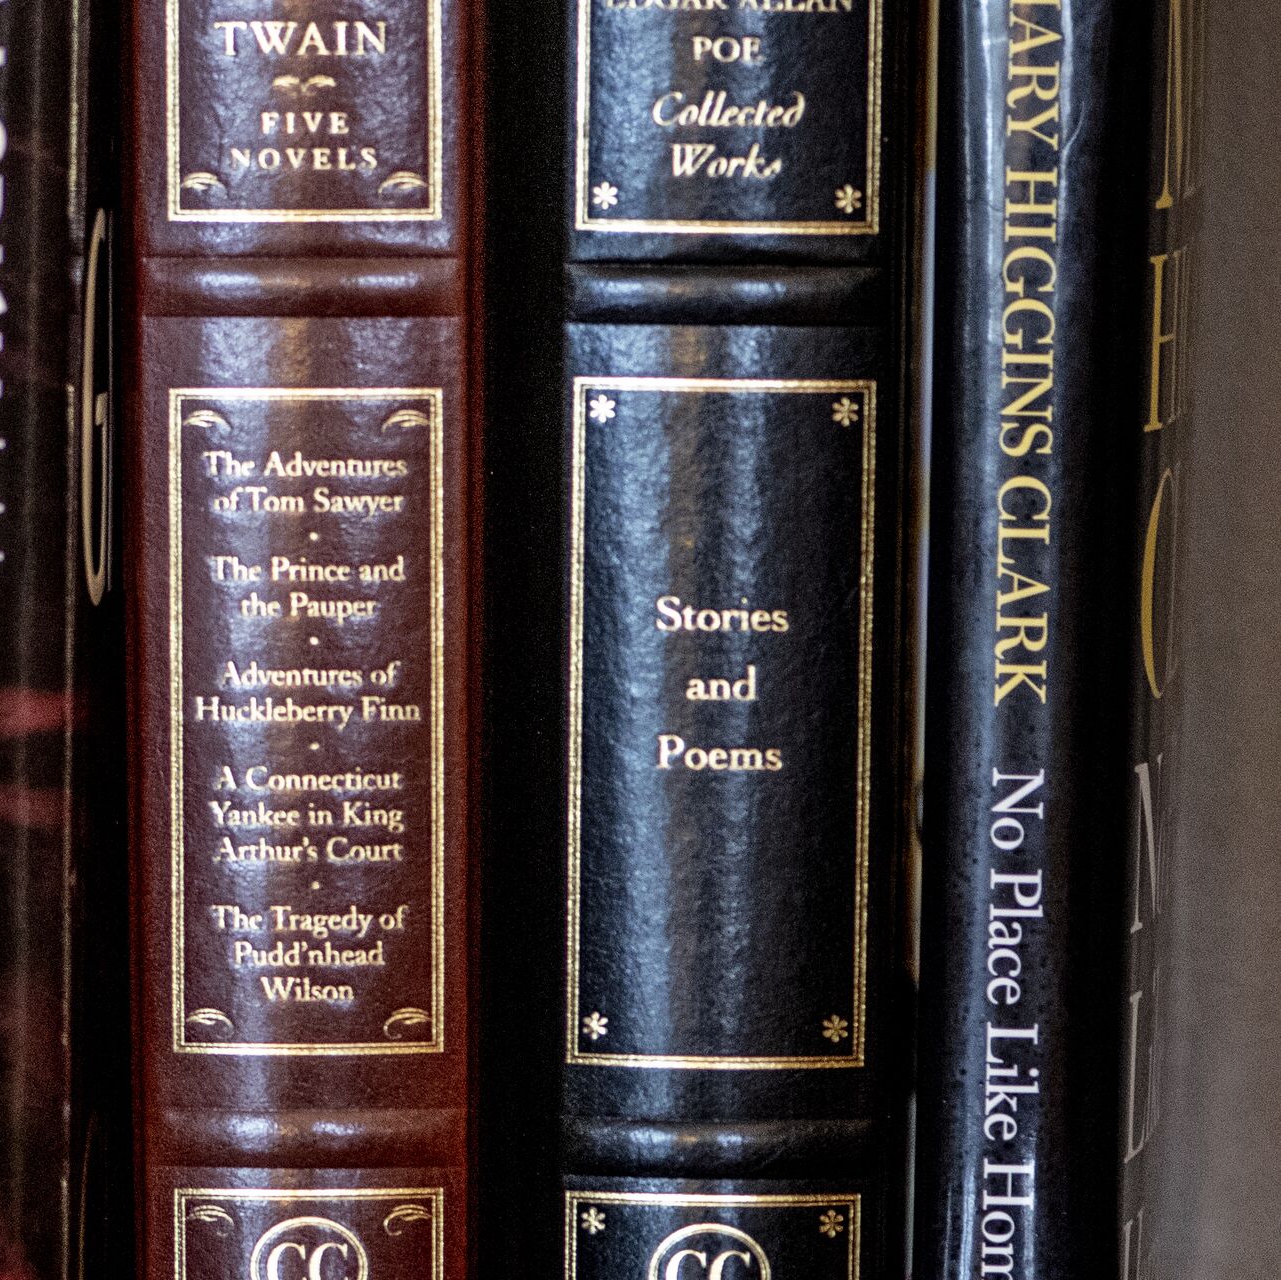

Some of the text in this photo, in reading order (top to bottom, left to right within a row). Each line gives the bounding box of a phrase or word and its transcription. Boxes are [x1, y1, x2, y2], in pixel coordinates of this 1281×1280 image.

[213, 21, 388, 56] TWAIN
[692, 36, 767, 62] POE
[261, 111, 350, 134] FIVE
[652, 90, 806, 127] Collected
[230, 147, 378, 170] NOVELS
[671, 142, 783, 179] Works
[999, 167, 1058, 457] HIGGINS
[203, 451, 408, 477] The Adventures
[213, 486, 404, 516] of Tom Sawyer
[210, 555, 406, 581] The Prince and
[240, 592, 377, 625] the Pauper
[994, 475, 1052, 708] CLARK
[655, 595, 790, 632] Stories
[222, 661, 402, 687] Adventures of
[686, 664, 758, 701] and
[195, 696, 420, 731] Huckleberry Finn
[656, 734, 784, 771] Poems
[215, 765, 403, 791] A Connecticut
[208, 801, 404, 833] Yankee in King
[990, 767, 1045, 851] No
[213, 836, 404, 862] Arthur's Court
[211, 904, 409, 939] The Tragedy of
[986, 869, 1044, 1006] Place
[234, 940, 385, 967] Pudd'nhead
[260, 976, 355, 1002] Wilson
[983, 1021, 1040, 1142] Like
